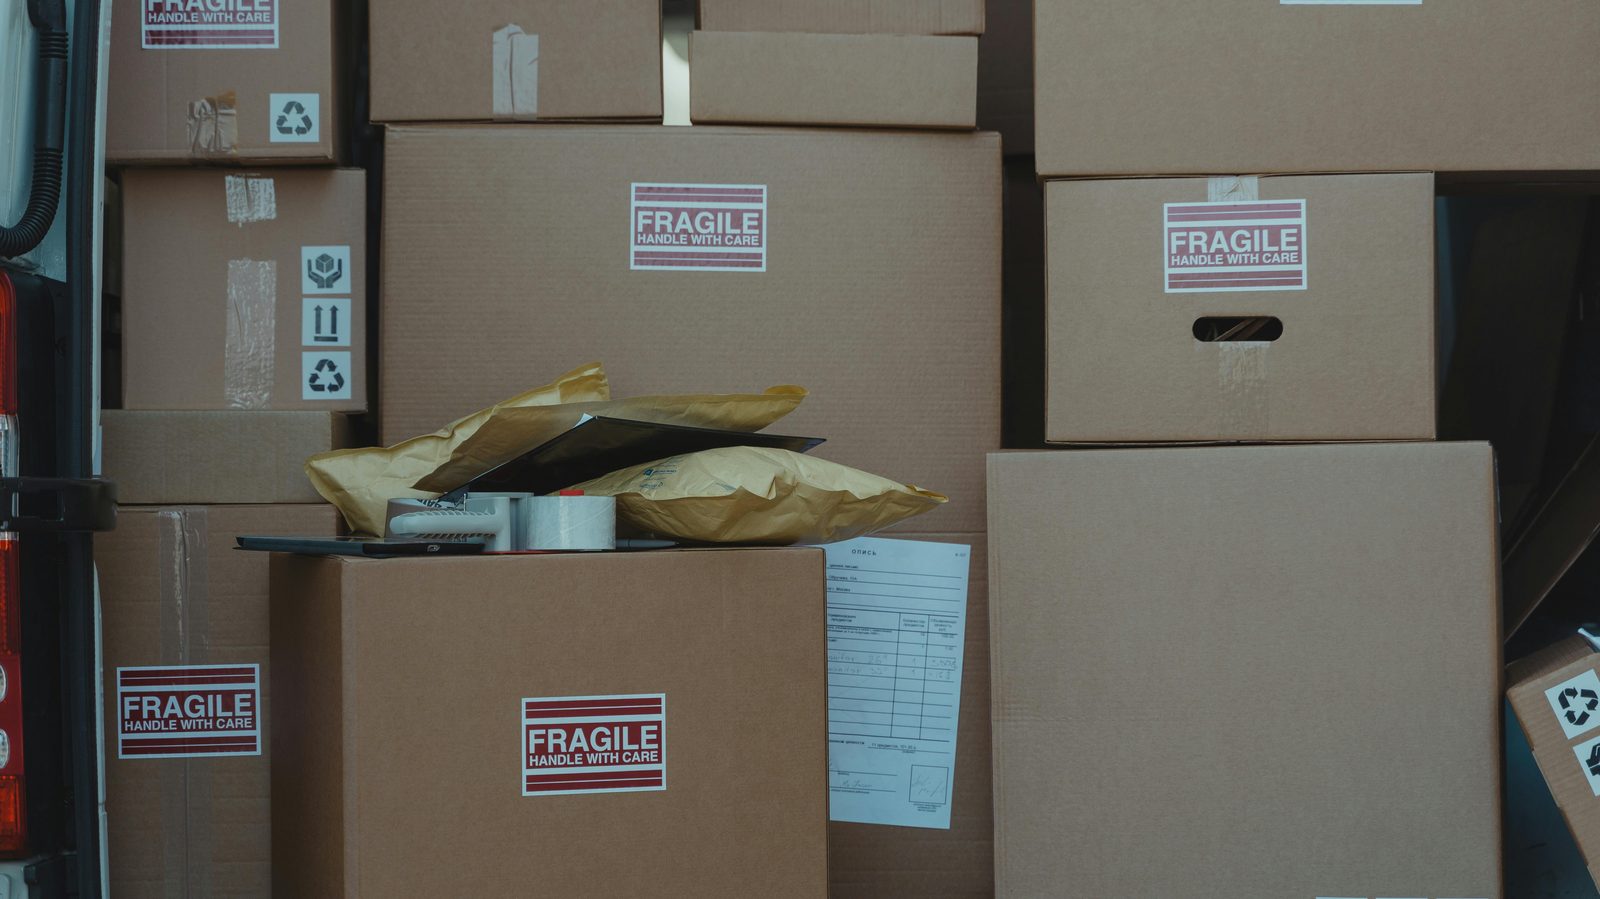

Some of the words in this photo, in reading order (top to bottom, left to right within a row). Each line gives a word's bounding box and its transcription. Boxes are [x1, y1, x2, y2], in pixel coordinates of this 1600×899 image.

[148, 12, 199, 23] HANDLE
[202, 12, 233, 23] WITH
[236, 12, 270, 23] CARE
[637, 210, 760, 235] FRAGILE
[637, 234, 688, 245] HANDLE
[690, 234, 722, 245] WITH
[724, 235, 760, 246] CARE
[1170, 228, 1299, 254] FRAGILE
[1171, 254, 1224, 266] HANDLE
[1226, 252, 1259, 264] WITH
[1262, 252, 1299, 264] CARE
[851, 548, 877, 556] ОПИСЬ
[123, 693, 253, 720] FRAGILE
[124, 719, 178, 732] HANDLE
[180, 718, 213, 731] WITH
[216, 717, 253, 729] CARE
[528, 725, 659, 754] FRAGILE
[529, 753, 583, 767] HANDLE
[586, 751, 619, 764] WITH
[622, 750, 659, 763] CARE
